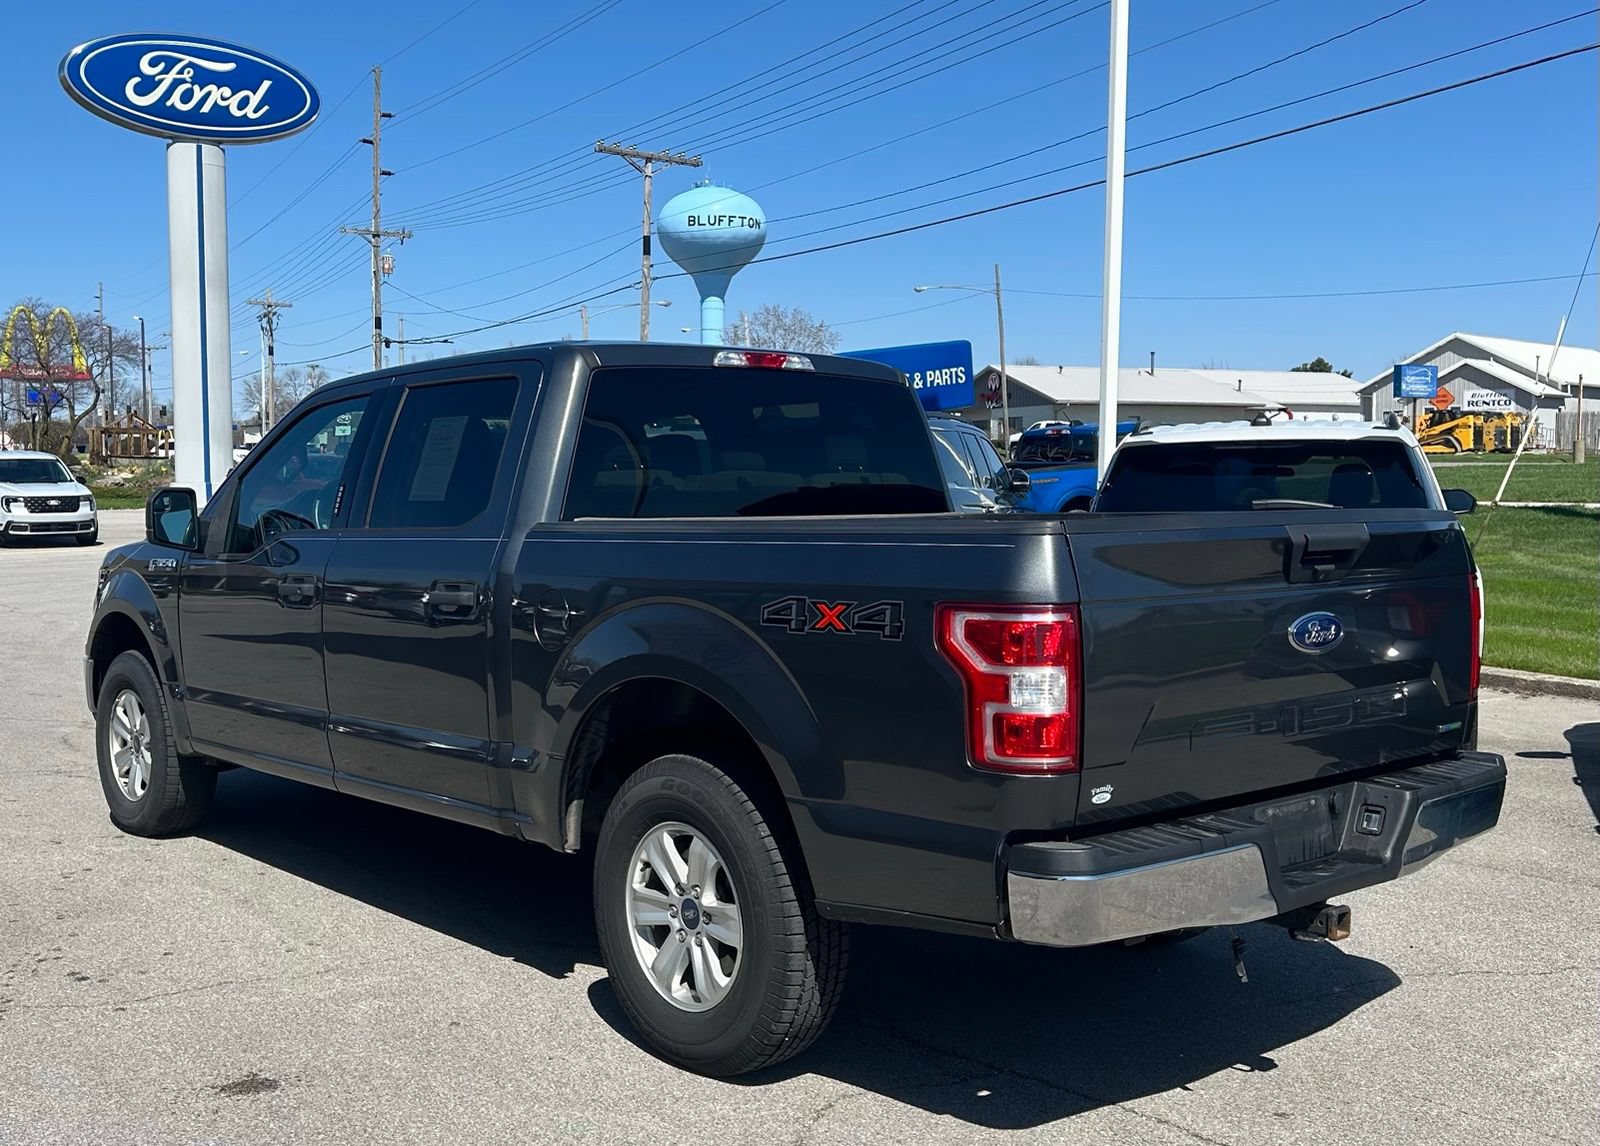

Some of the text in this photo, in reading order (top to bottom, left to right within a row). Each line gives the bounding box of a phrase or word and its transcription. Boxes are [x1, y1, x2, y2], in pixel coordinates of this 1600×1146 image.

[124, 50, 273, 120] Ford
[687, 214, 761, 230] BLUFFTON
[913, 371, 924, 389] &
[926, 366, 966, 388] PARTS
[1467, 399, 1512, 407] RENTCO
[1471, 391, 1508, 399] Bluffton
[1304, 620, 1336, 644] Ford
[1091, 784, 1114, 796] Family
